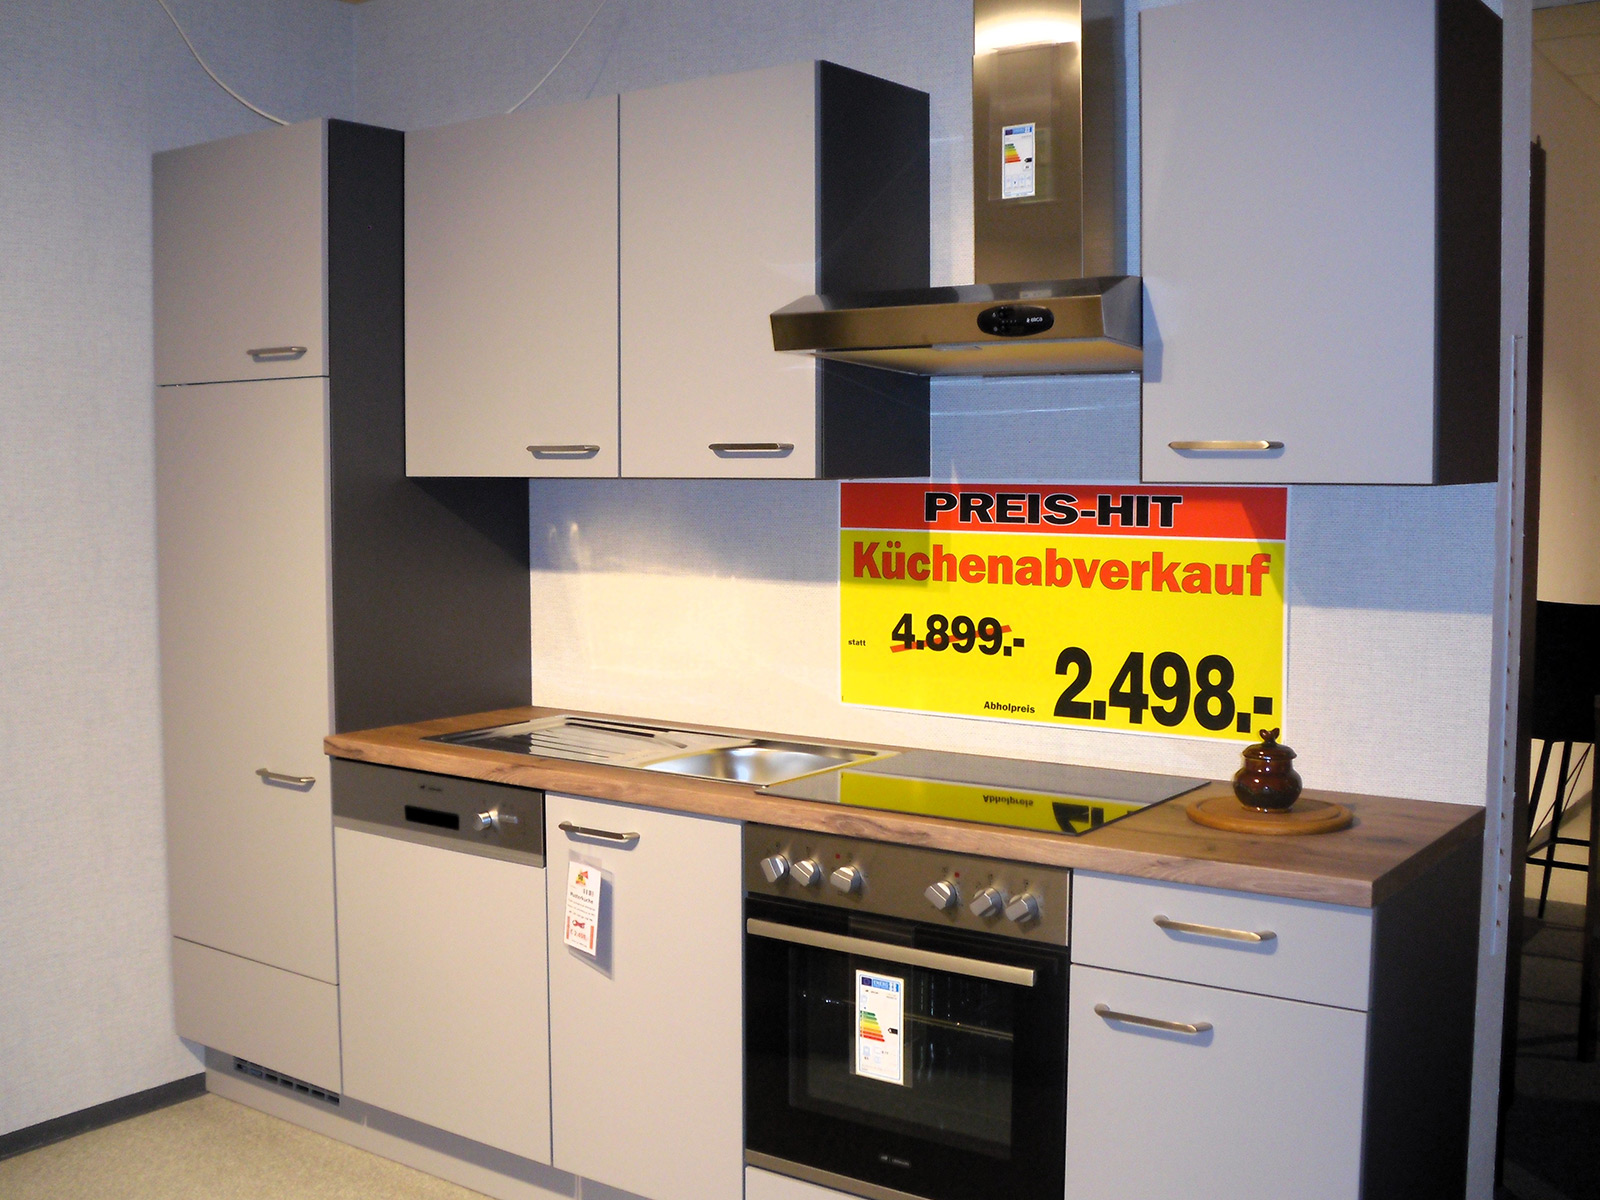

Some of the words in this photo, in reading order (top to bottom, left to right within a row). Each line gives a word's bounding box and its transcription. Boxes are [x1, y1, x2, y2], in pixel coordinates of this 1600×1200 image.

[924, 491, 1183, 529] PREIS-HIT
[853, 540, 1272, 597] Küchenabverkauf
[848, 638, 866, 647] statt
[891, 613, 1025, 657] 4.899.-
[983, 700, 1036, 714] Abholpreis
[1053, 646, 1274, 734] 2.498.-
